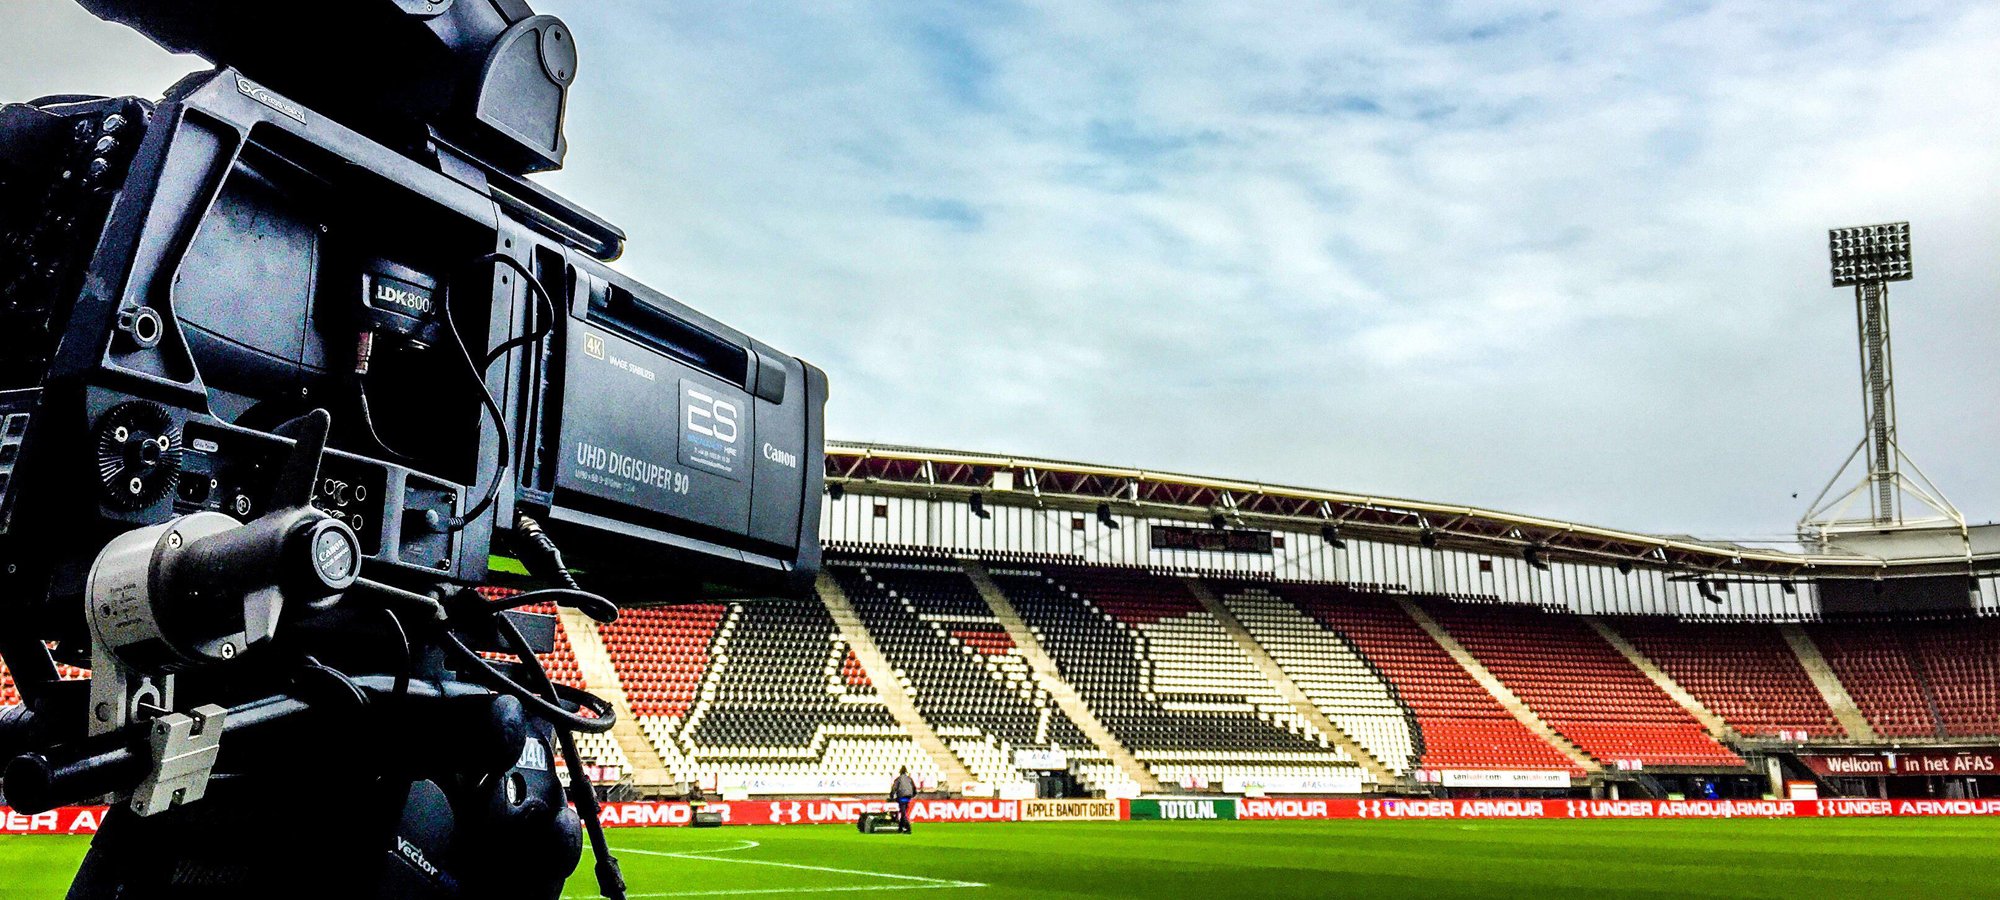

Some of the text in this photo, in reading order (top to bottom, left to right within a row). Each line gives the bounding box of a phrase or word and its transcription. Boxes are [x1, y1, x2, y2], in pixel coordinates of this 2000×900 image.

[586, 337, 601, 356] 4K
[687, 389, 738, 443] ES
[763, 442, 797, 468] Canon
[577, 442, 607, 470] UHD
[608, 451, 672, 490] DIGISUPER
[674, 471, 690, 495] 90
[1827, 756, 1994, 772] Welkom in het AFAS
[1026, 803, 1115, 818] APPLE BANDIT CIDER
[1158, 800, 1218, 819] TOTO.NL
[1385, 801, 1544, 817] UNDER ARMOUR
[1591, 801, 1653, 816] UNDER
[1838, 801, 1892, 815] UNDER
[397, 835, 438, 876] Vector
